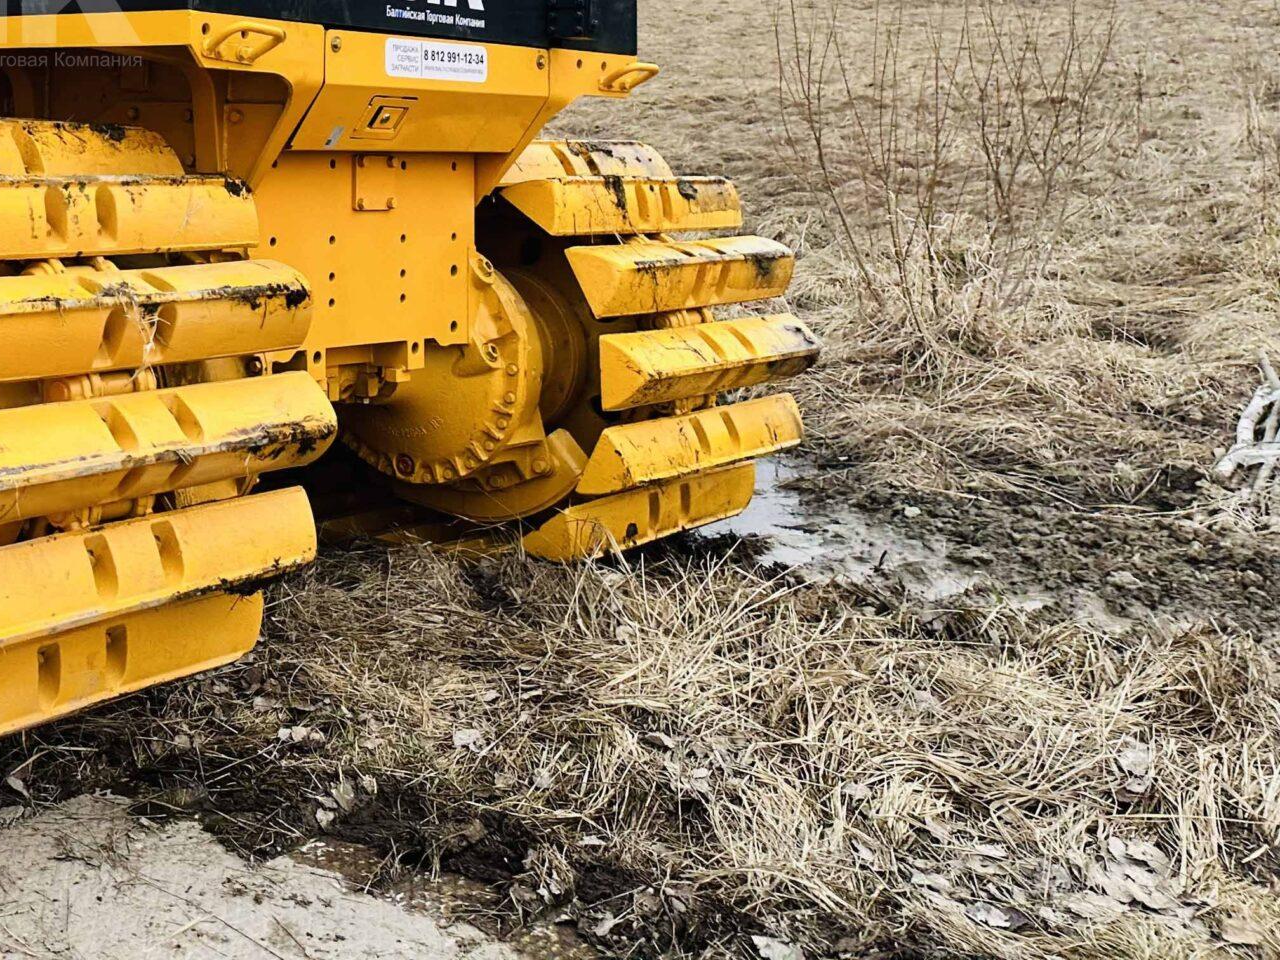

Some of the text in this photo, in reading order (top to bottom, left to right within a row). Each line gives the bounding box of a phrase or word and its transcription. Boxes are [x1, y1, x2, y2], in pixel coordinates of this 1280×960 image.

[386, 5, 486, 29] Балтийская Торговая Компания
[423, 49, 485, 65] 8 812 991-12-34
